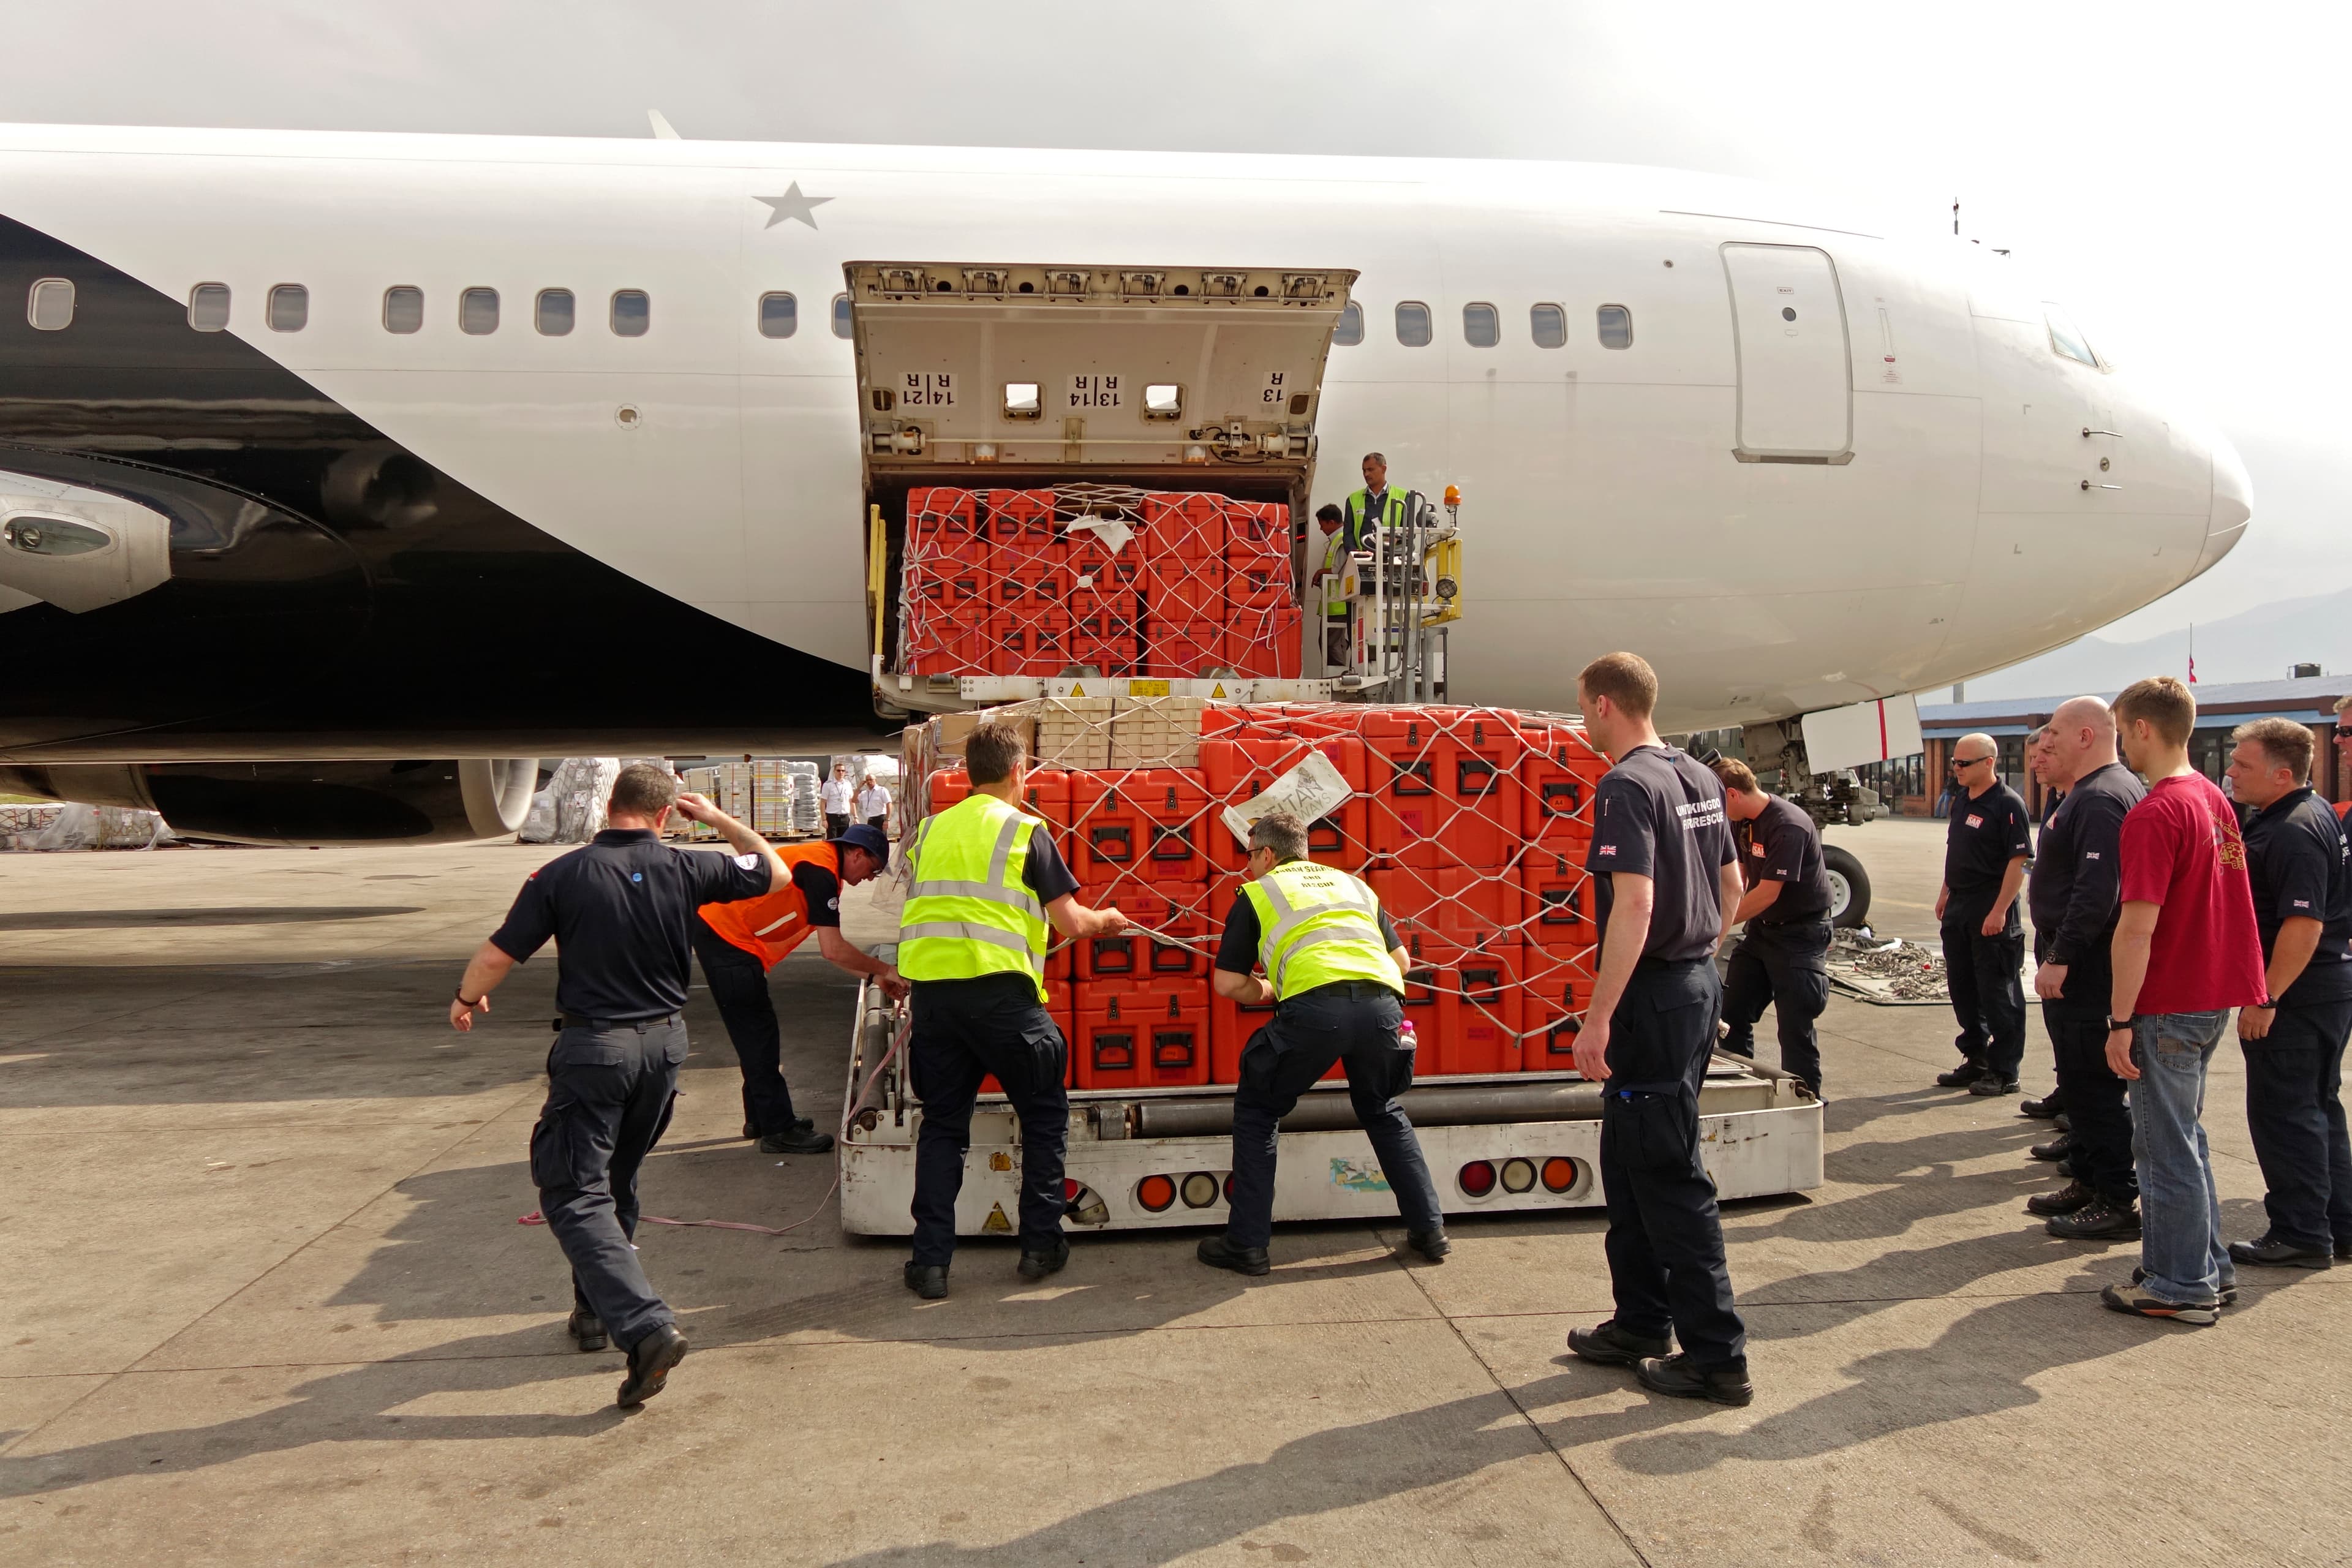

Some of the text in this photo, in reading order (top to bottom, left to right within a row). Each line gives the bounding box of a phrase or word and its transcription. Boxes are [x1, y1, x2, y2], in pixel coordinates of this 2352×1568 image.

[907, 374, 949, 387] R R
[1076, 376, 1117, 389] R R
[1271, 372, 1283, 385] R
[903, 391, 954, 405] 14 21
[1069, 393, 1120, 406] 13 14
[1263, 389, 1283, 402] 13
[1297, 792, 1332, 821] WAYS
[1689, 797, 1721, 814] KINGDO
